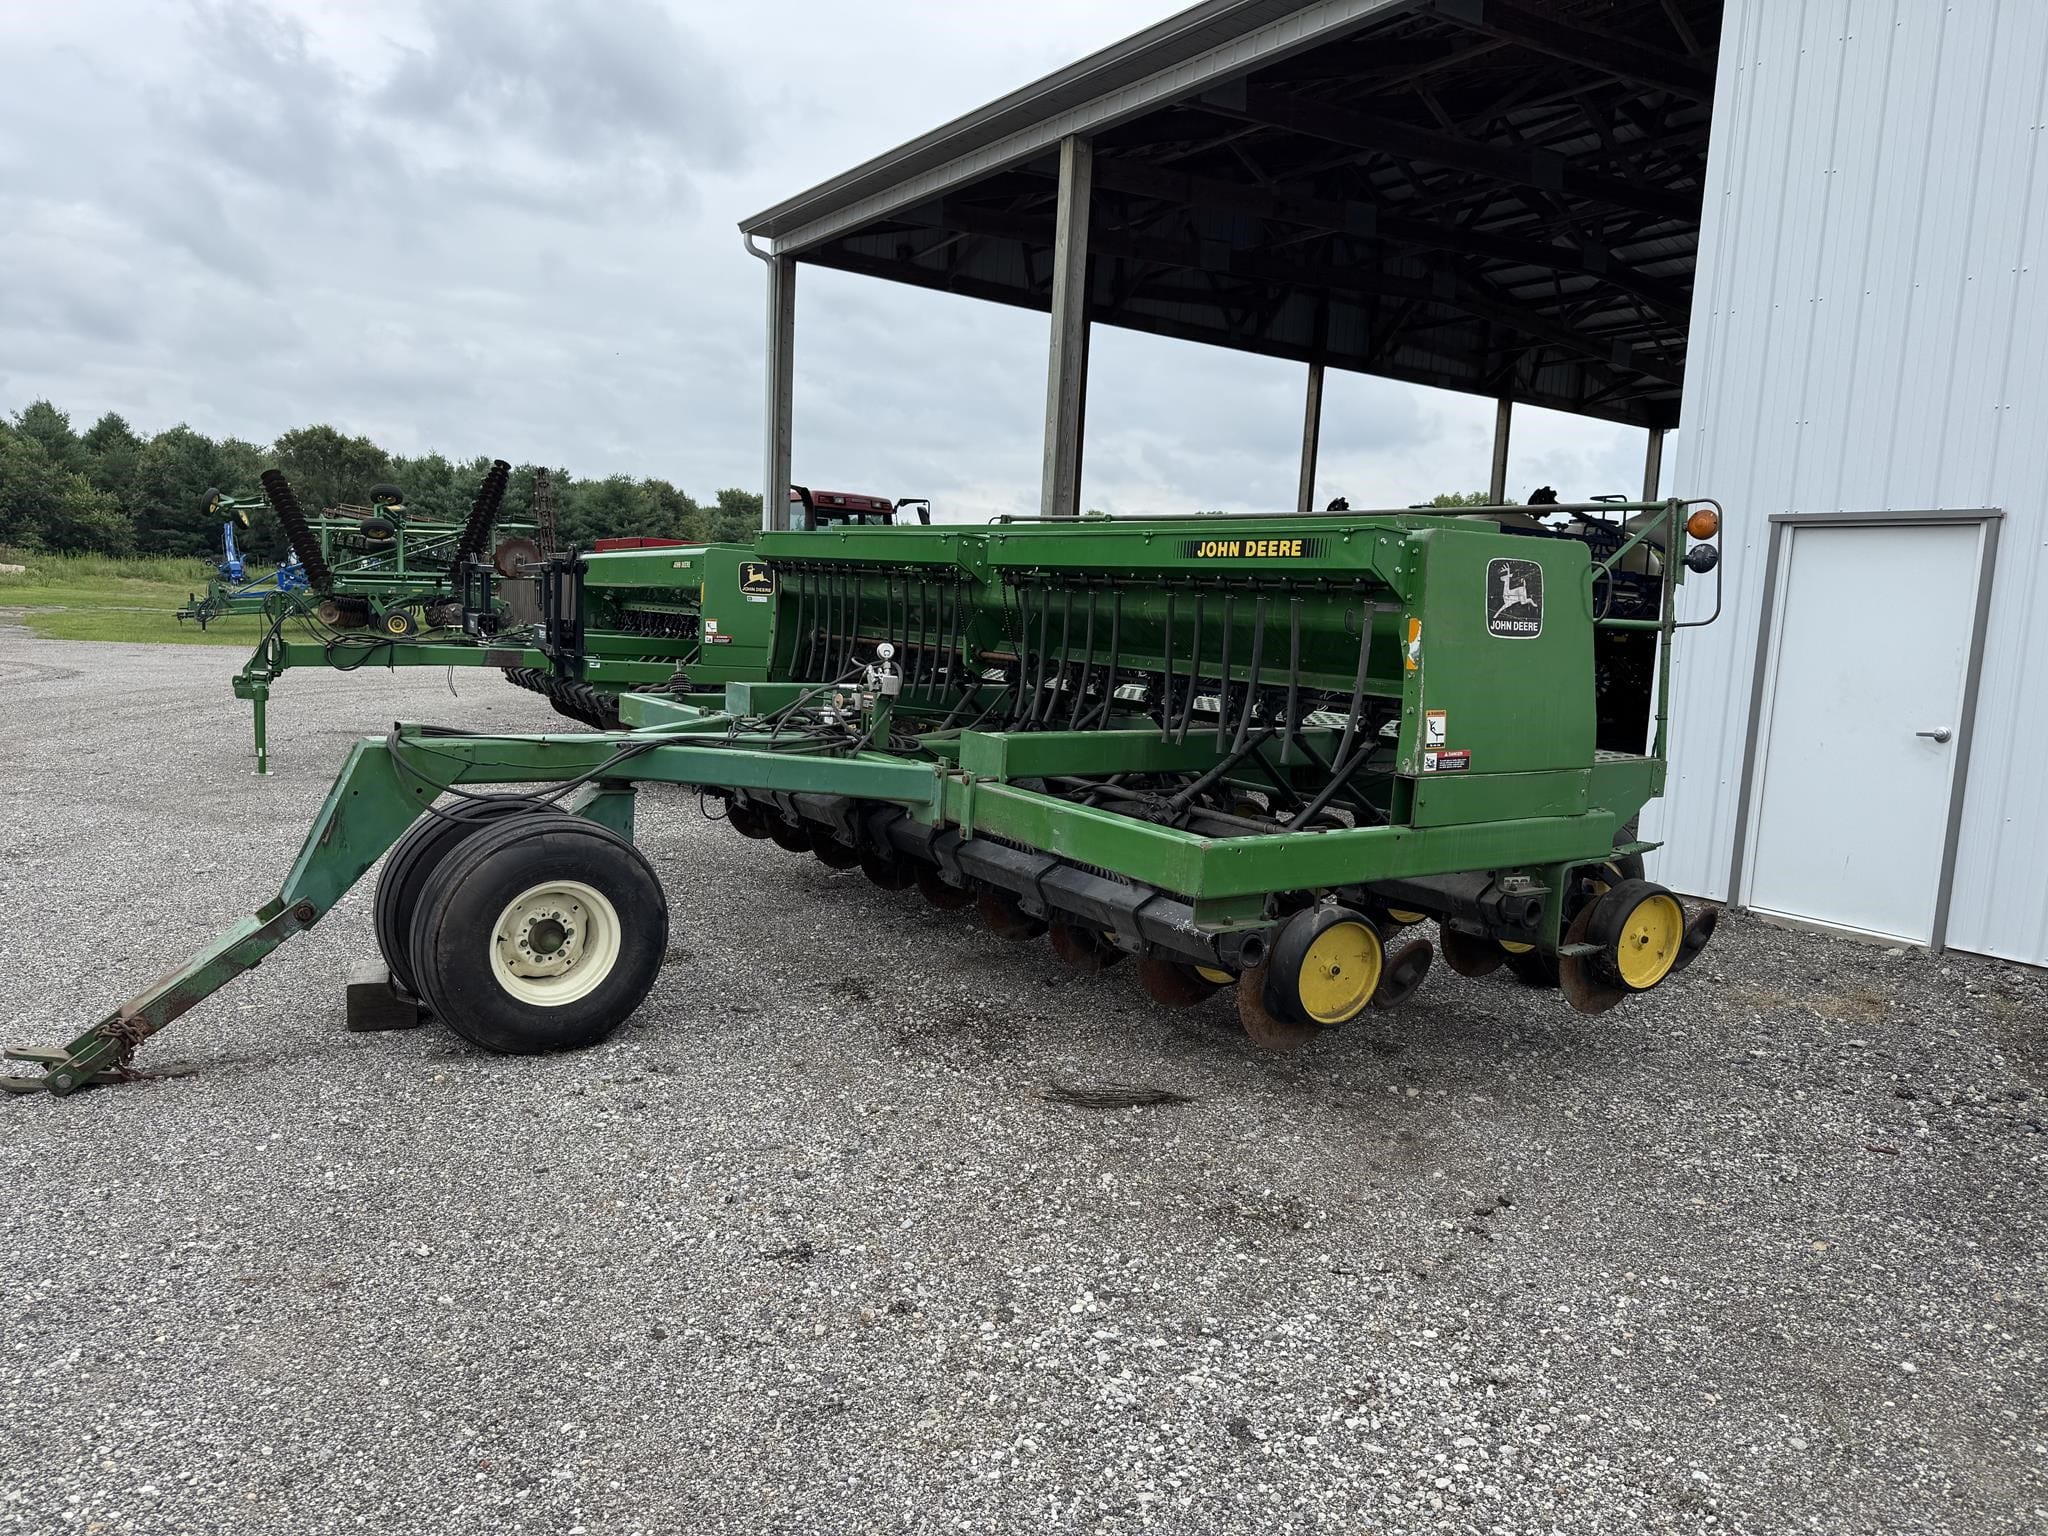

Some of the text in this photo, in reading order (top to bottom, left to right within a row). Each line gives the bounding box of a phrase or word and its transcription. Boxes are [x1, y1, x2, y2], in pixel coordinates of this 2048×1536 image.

[1197, 540, 1302, 557] JOHN DEERE
[1490, 620, 1539, 632] JOHN DEERE
